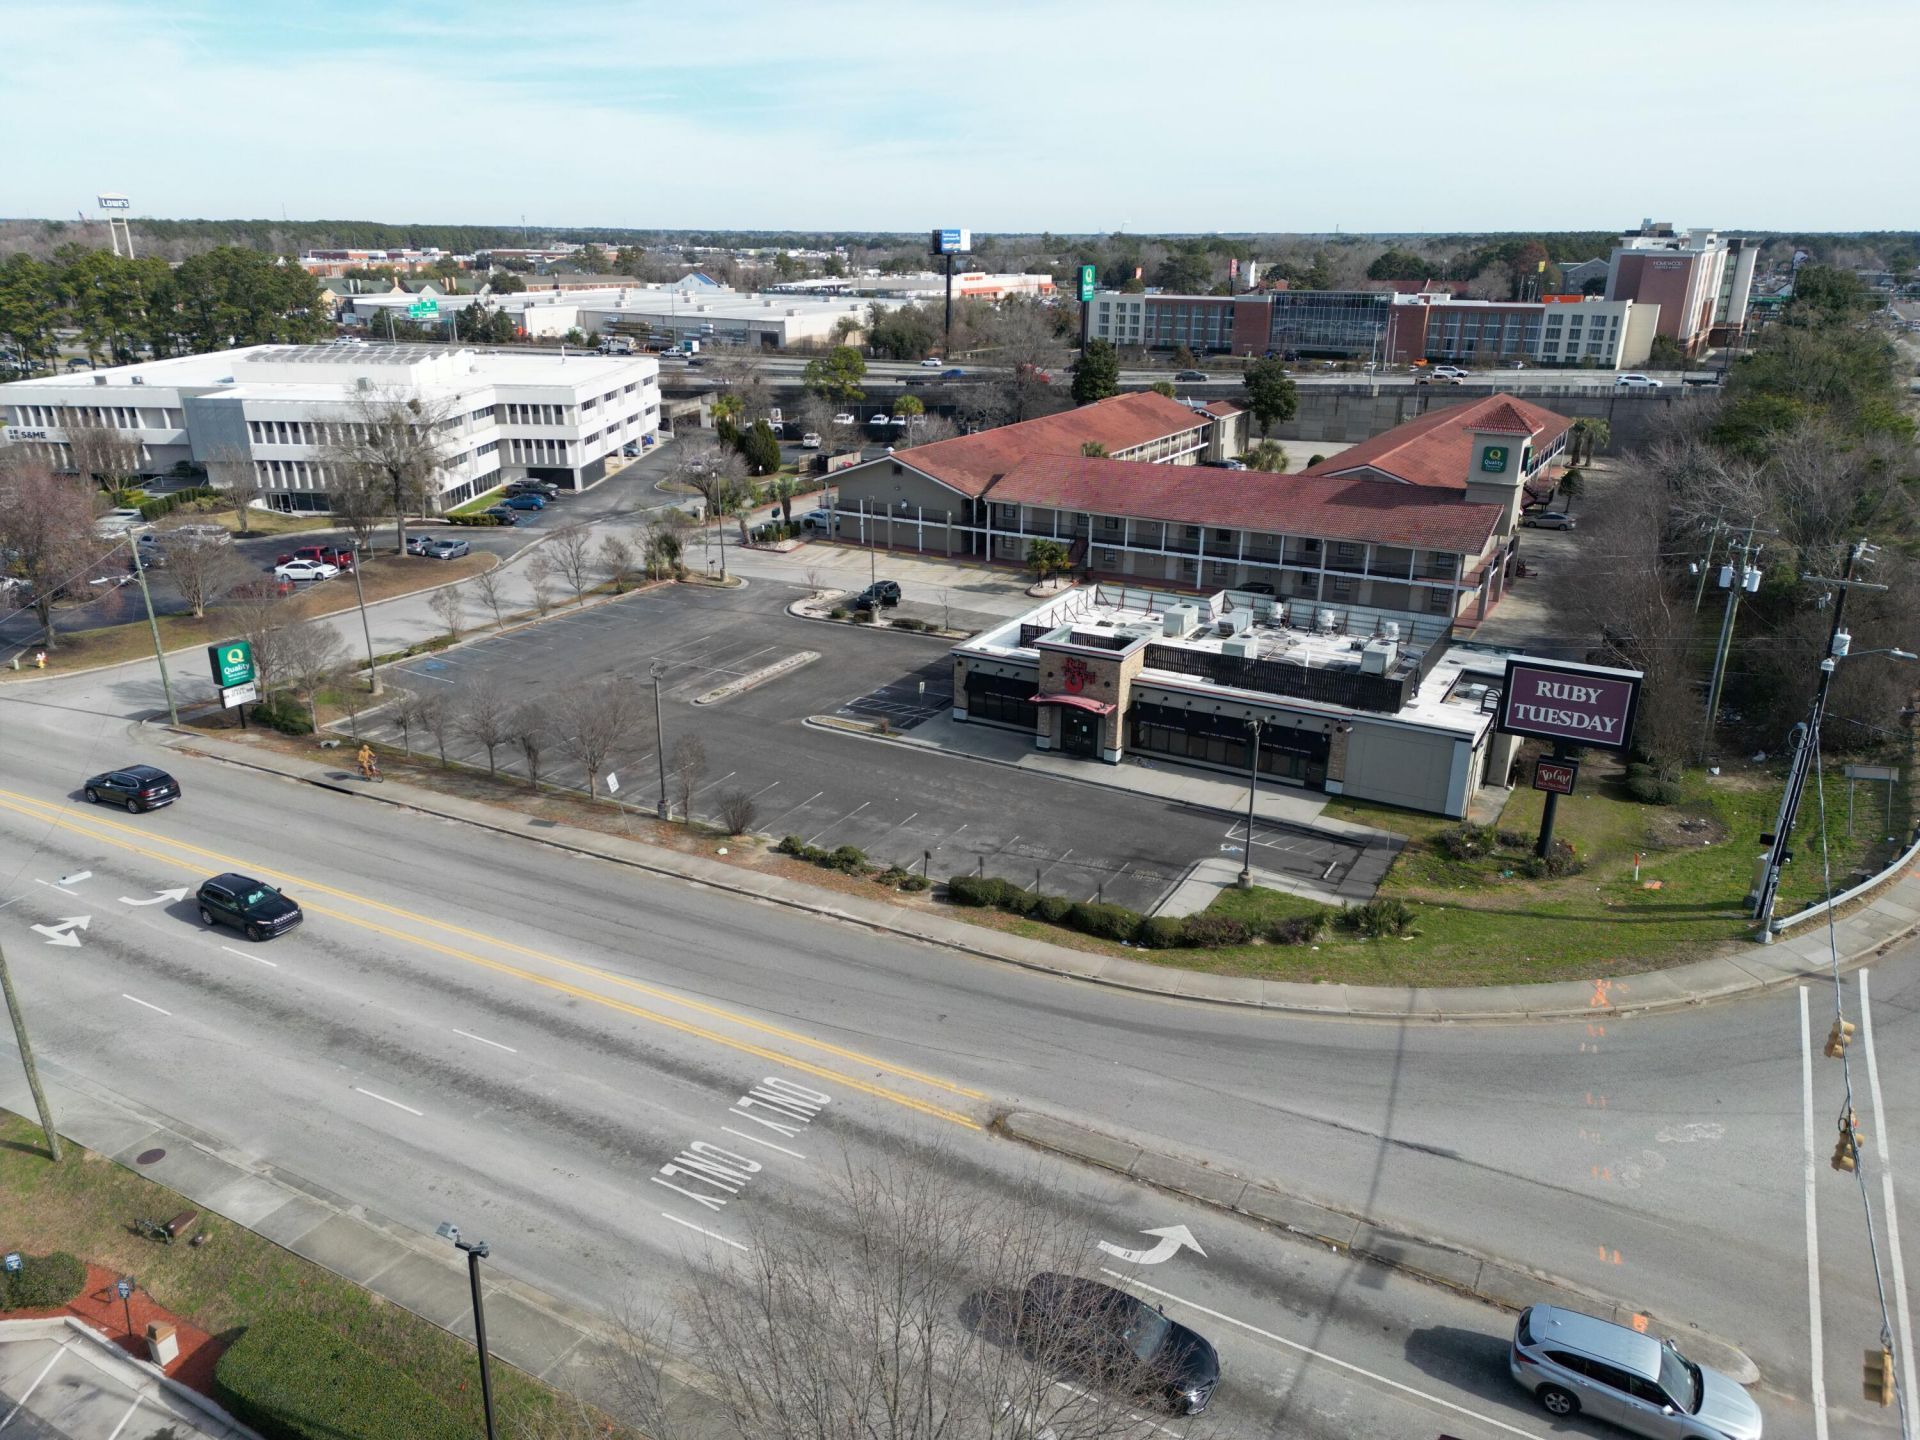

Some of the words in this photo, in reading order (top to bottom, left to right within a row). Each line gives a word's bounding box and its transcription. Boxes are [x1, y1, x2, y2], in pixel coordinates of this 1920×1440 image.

[20, 431, 47, 439] S&ME
[1484, 458, 1503, 467] Quality
[1490, 449, 1501, 460] Q
[227, 648, 245, 664] Q
[223, 663, 250, 675] Quality
[1535, 680, 1604, 705] RUBY
[1514, 702, 1619, 733] TUESDAY
[728, 1076, 832, 1138] ONLY
[650, 1141, 762, 1211] ONLY
